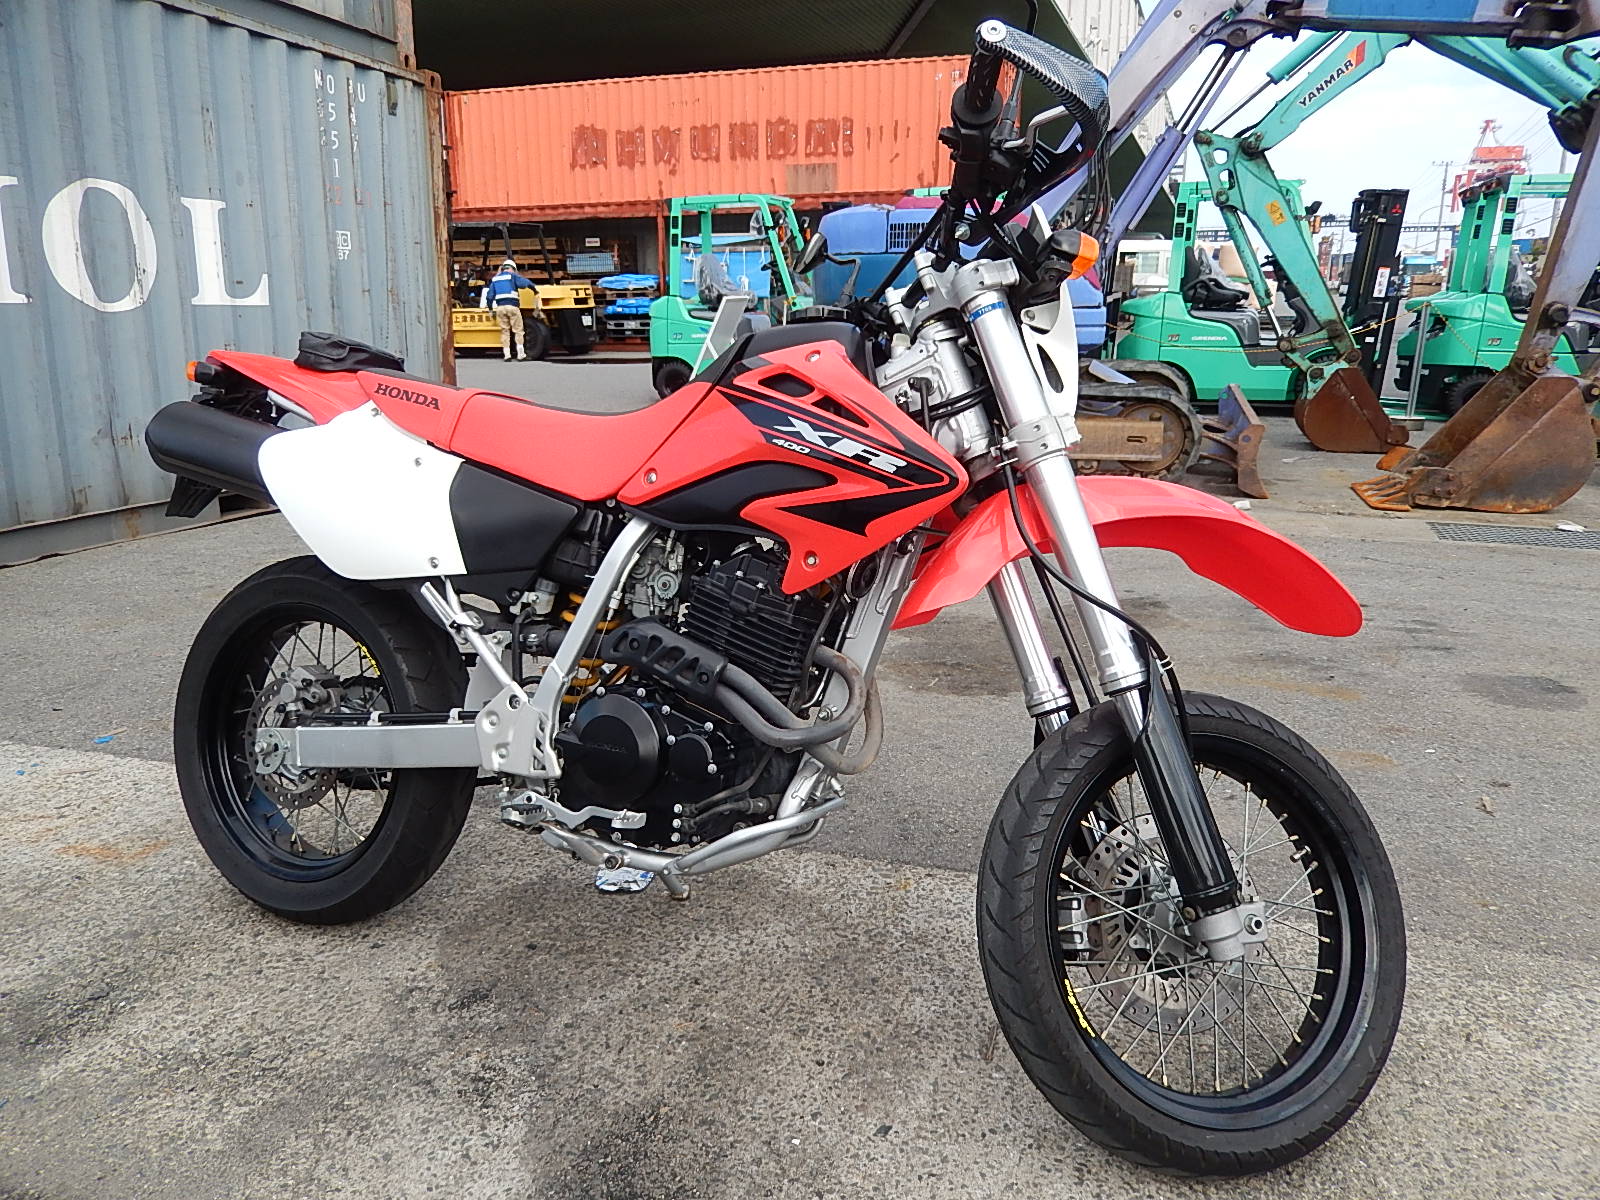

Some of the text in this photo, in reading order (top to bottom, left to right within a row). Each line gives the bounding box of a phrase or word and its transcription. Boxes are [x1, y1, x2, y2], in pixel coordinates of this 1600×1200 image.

[1298, 59, 1355, 107] YANMAR
[374, 383, 440, 411] HONDA
[771, 438, 811, 454] 400
[773, 416, 908, 474] XR
